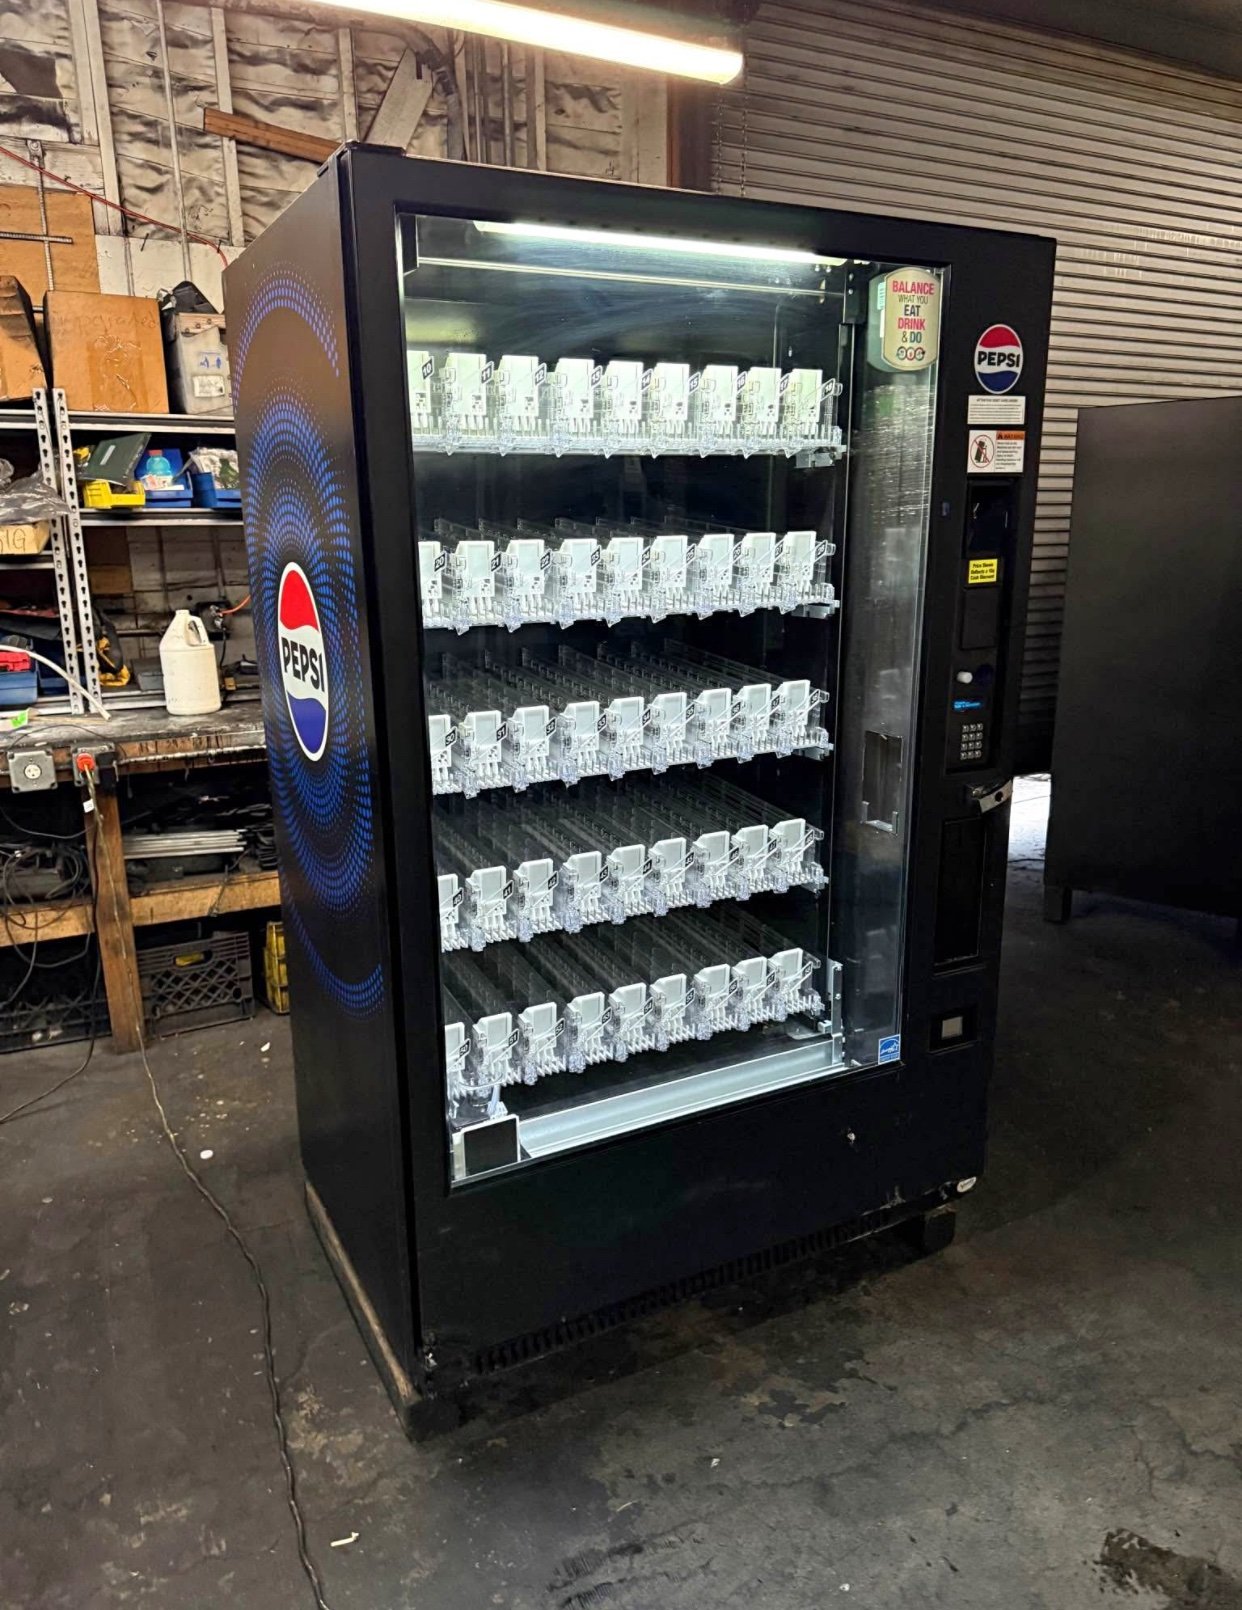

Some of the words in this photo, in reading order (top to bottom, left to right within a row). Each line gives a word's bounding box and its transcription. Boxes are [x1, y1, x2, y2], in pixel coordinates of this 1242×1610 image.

[892, 281, 935, 295] BALANCE
[898, 294, 915, 303] WHAT
[917, 296, 929, 304] YOU
[904, 305, 920, 317] EAT
[898, 318, 926, 330] DRINK
[902, 331, 907, 343] &
[910, 332, 922, 343] DO
[977, 351, 1021, 368] PEPSI
[281, 637, 325, 692] PEPSI
